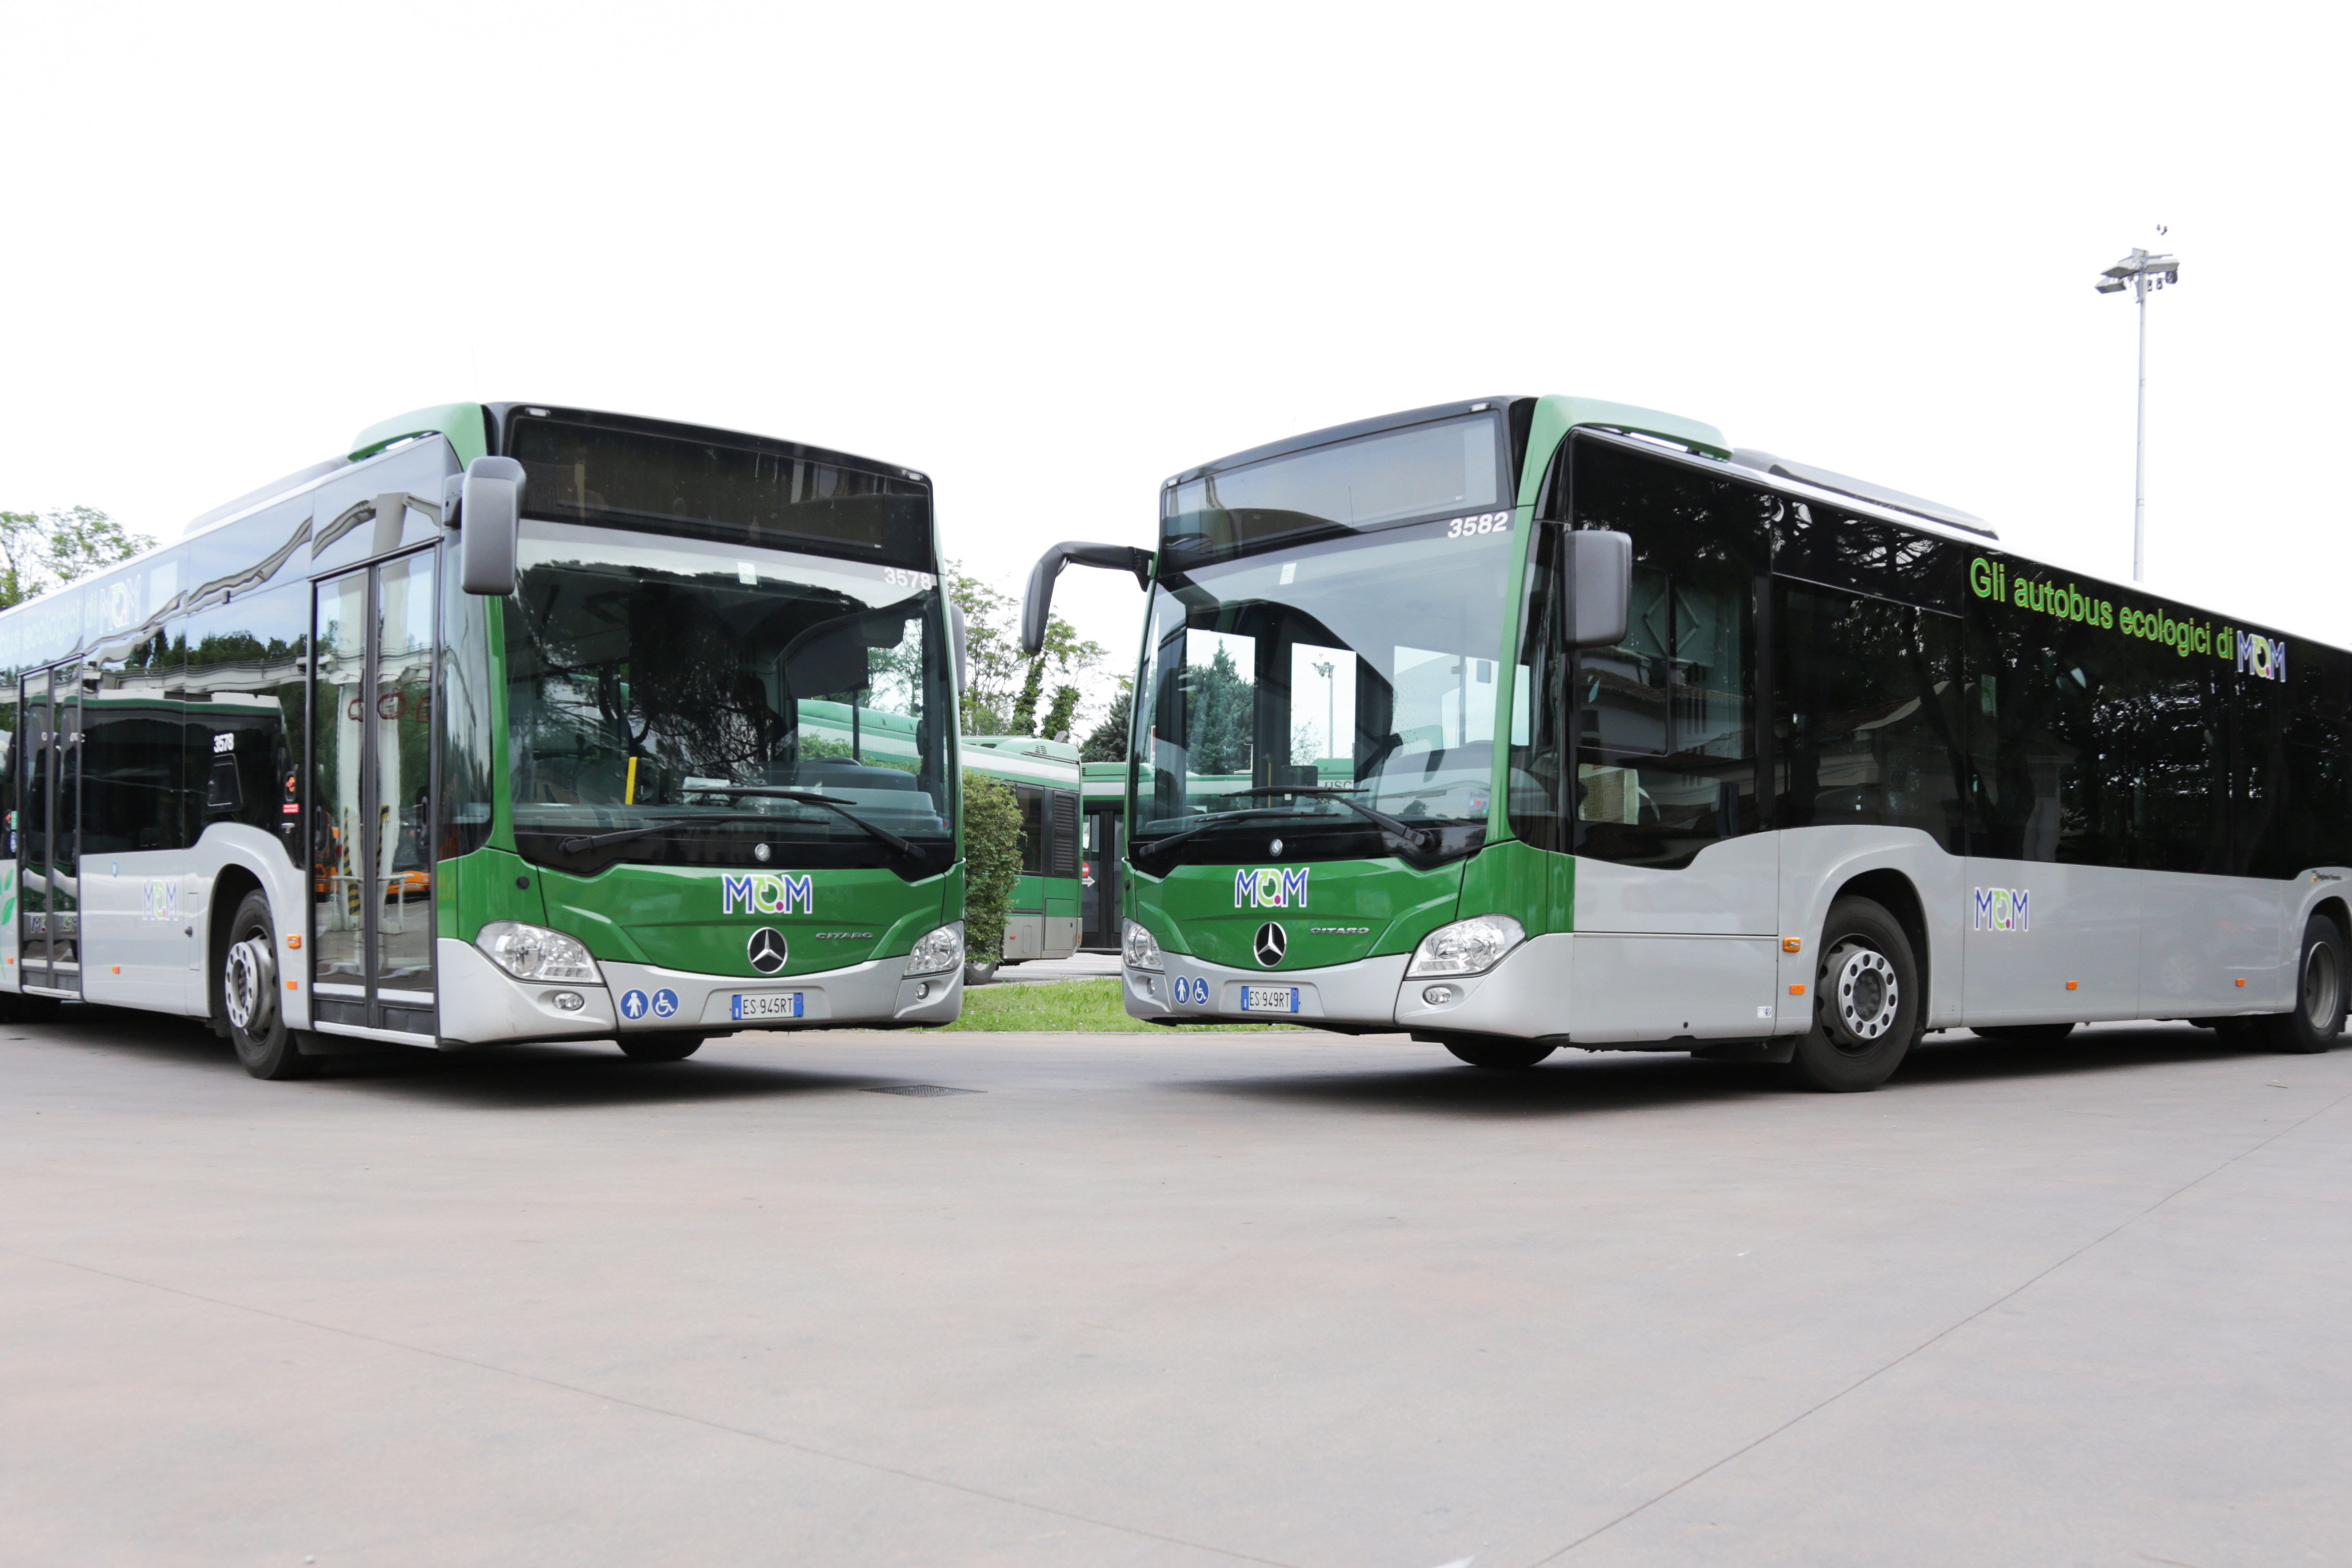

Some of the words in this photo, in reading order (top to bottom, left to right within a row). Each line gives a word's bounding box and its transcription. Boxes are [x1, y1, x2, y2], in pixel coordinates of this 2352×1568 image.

[1447, 511, 1508, 539] 3582
[884, 567, 932, 591] 3578
[1970, 557, 2005, 602] Gli
[2014, 578, 2113, 629] autobus
[2119, 607, 2211, 657] ecologici
[2216, 627, 2234, 660] di
[214, 732, 234, 753] 3578
[1310, 926, 1369, 935] CITARO
[743, 999, 756, 1014] ES
[760, 998, 793, 1014] 945RT
[1250, 991, 1260, 1006] ES
[1262, 991, 1290, 1008] 949RT
